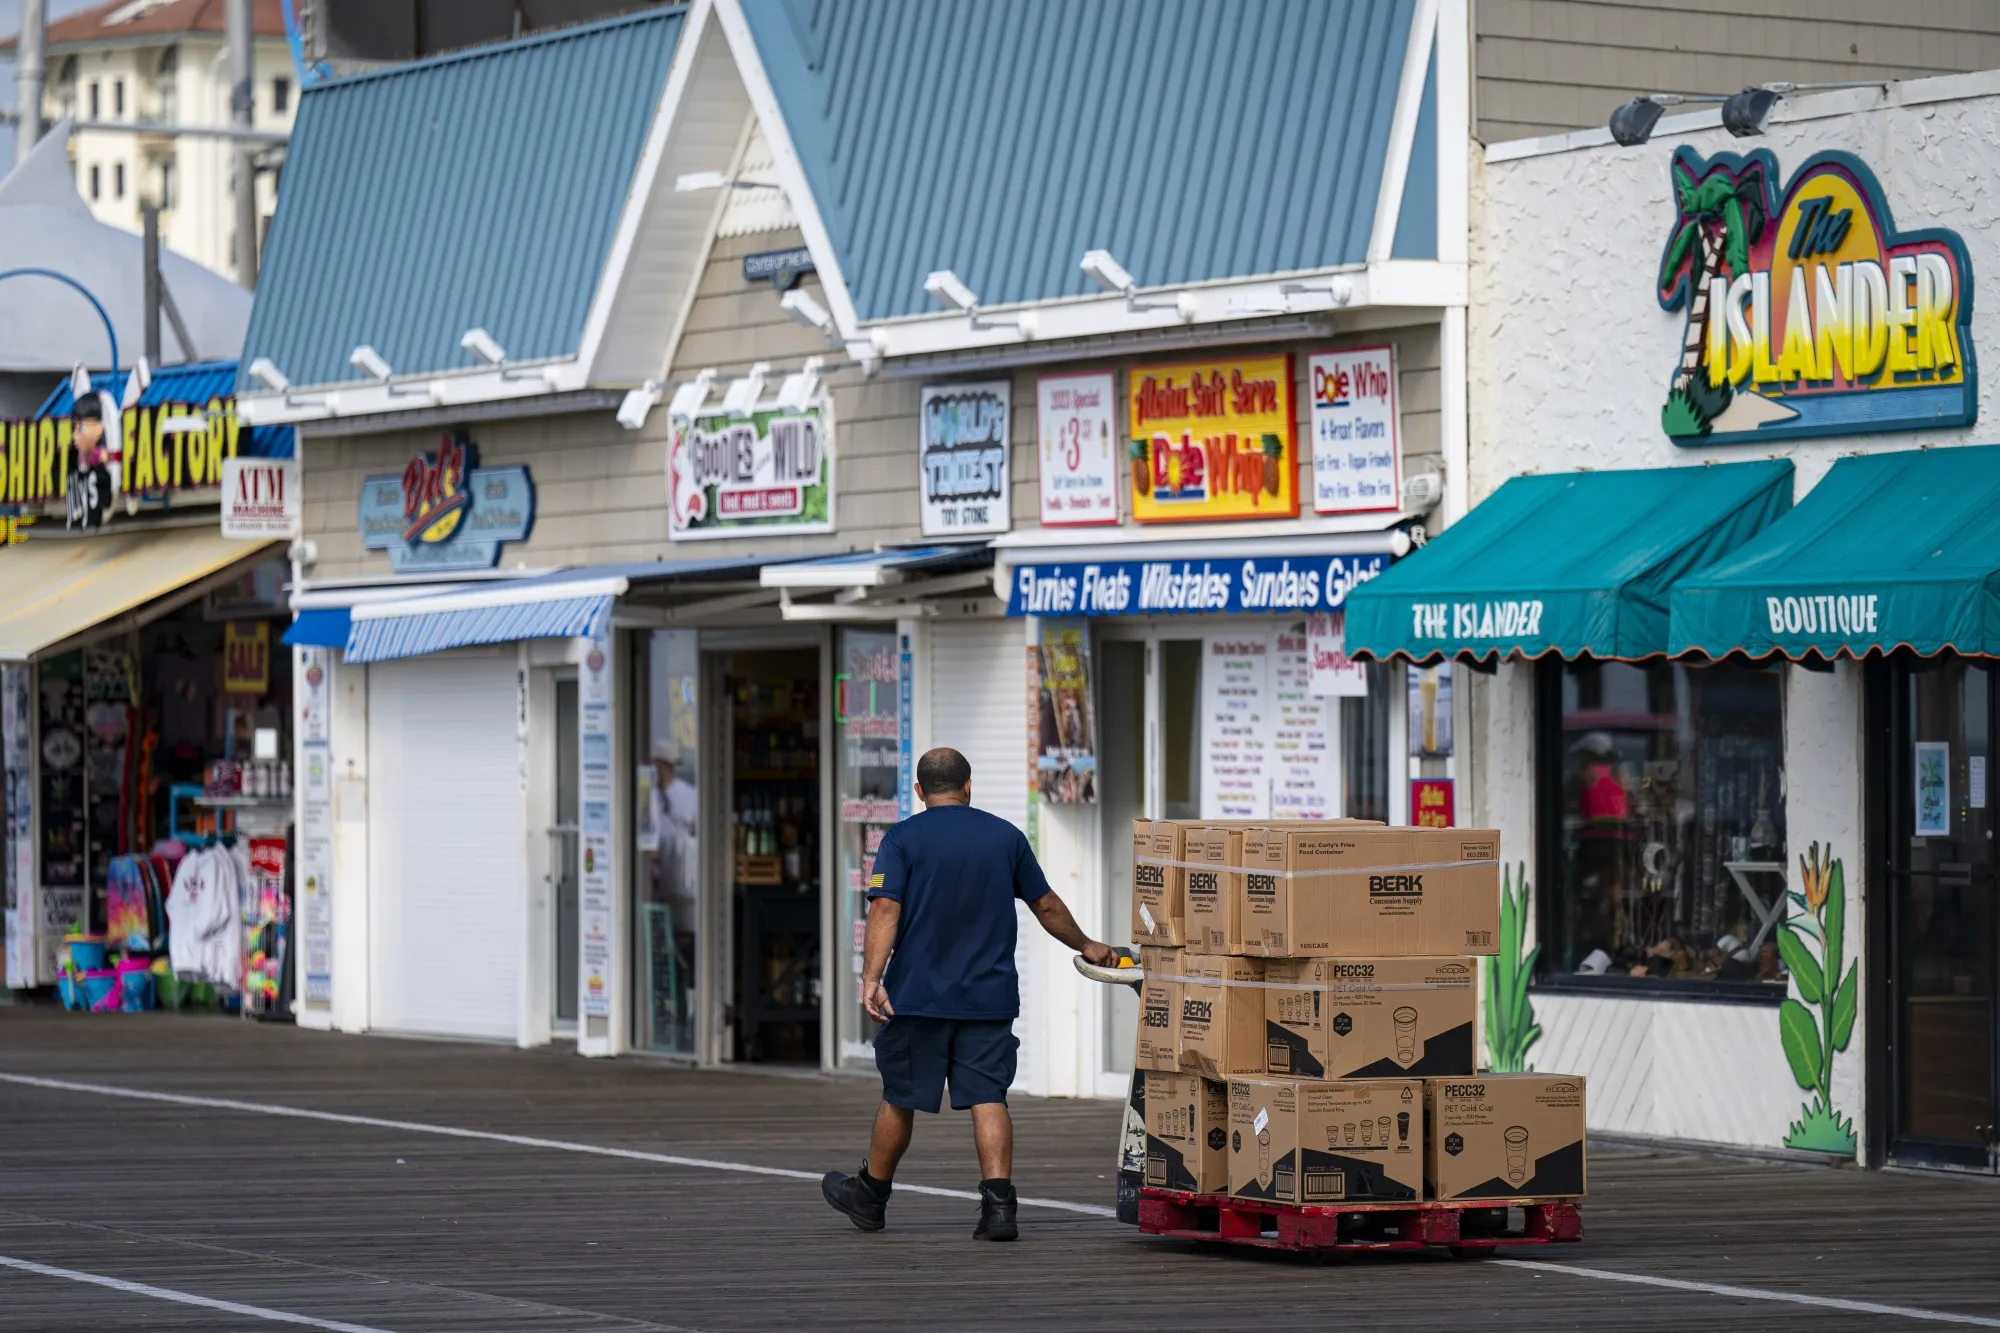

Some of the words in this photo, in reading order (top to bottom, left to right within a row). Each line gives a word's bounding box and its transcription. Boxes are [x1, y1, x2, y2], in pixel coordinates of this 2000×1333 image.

[1787, 196, 1852, 259] The
[1708, 252, 1957, 389] ISLANDER
[1190, 370, 1226, 417] Soft
[1232, 367, 1278, 415] Serve
[1314, 363, 1349, 401] Dole
[1352, 361, 1388, 404] Whip
[121, 396, 240, 494] FACTORY
[771, 420, 817, 482] WILD
[1152, 433, 1205, 487] Dole
[1204, 433, 1264, 506] Whip
[234, 466, 285, 504] ATM
[961, 506, 989, 526] STORE
[1080, 565, 1131, 611] Floats
[1138, 561, 1232, 609] Milkshakes
[1240, 560, 1320, 608] Sundaes
[1326, 557, 1381, 607] Gel
[1412, 603, 1447, 639] THE
[1453, 600, 1543, 639] ISLANDER
[1767, 595, 1877, 636] BOUTIQUE
[228, 640, 265, 678] SALE
[1318, 842, 1339, 850] Curly's
[1135, 864, 1164, 883] BERK
[1189, 872, 1218, 889] BERK
[1247, 874, 1276, 890] BERK
[1369, 874, 1423, 891] BERK
[1369, 897, 1401, 905] Concession
[1402, 897, 1423, 906] Supply
[1333, 964, 1374, 977] PECC32
[1436, 967, 1470, 975] ecopax
[1368, 985, 1383, 993] Cup
[1183, 999, 1212, 1018] BERK
[1445, 1084, 1485, 1097] PECC32
[1546, 1086, 1580, 1095] ecopax
[1445, 1104, 1458, 1112] PET
[1460, 1104, 1476, 1112] Cold
[1479, 1104, 1493, 1112] Cup
